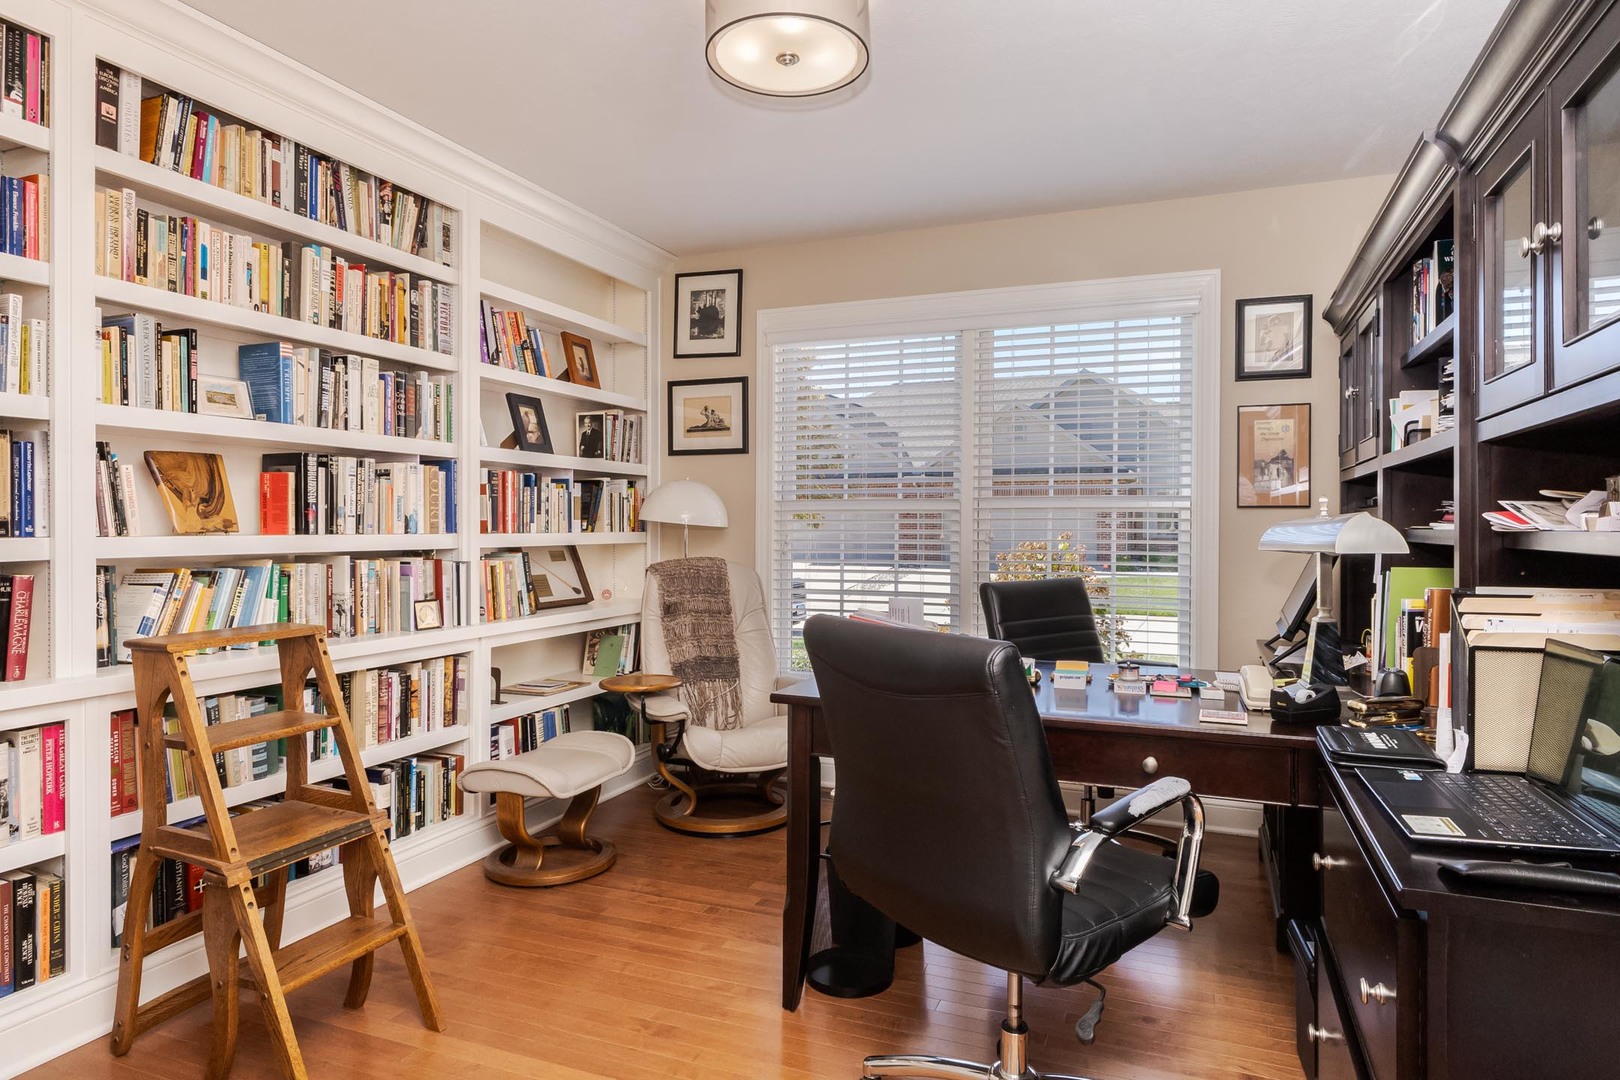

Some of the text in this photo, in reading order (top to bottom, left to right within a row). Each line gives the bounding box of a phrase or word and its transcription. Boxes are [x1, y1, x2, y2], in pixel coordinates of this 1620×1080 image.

[98, 75, 119, 87] DISCOVERY
[99, 71, 119, 81] EUROPEAN
[100, 85, 118, 96] AMERICA
[124, 101, 132, 144] COLONIES
[439, 302, 449, 337] VICTORY
[143, 318, 151, 379] AMERICAN EPOCH
[430, 467, 439, 523] COURT
[230, 587, 243, 617] ILLINOIS
[11, 590, 27, 655] CHARLEMAGNE
[121, 852, 129, 897] God's Politics
[52, 881, 60, 914] THUNDER
[53, 920, 61, 944] CHINA
